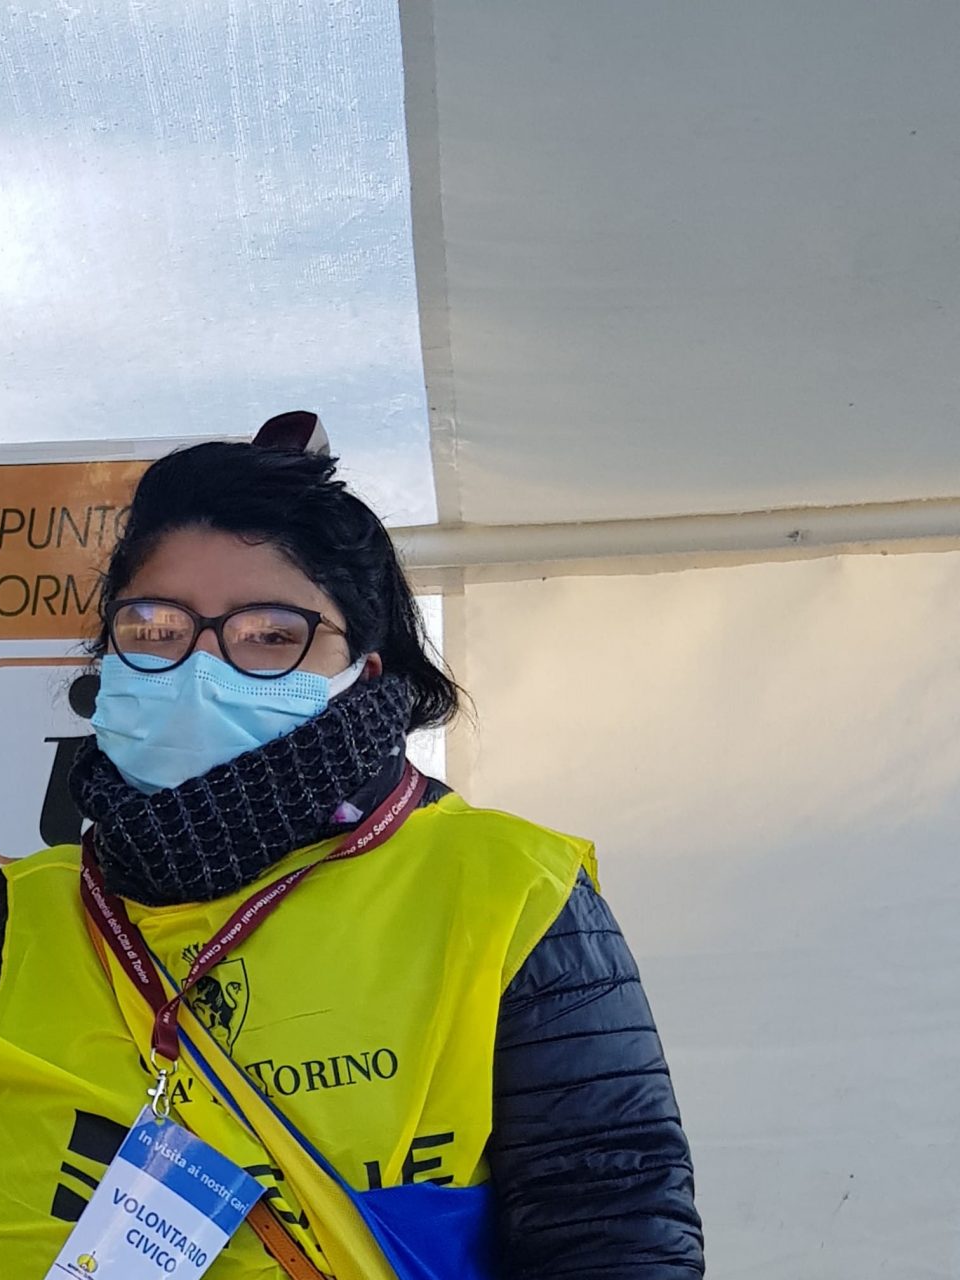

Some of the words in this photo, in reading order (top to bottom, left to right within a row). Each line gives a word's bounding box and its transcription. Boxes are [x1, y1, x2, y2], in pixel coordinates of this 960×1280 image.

[357, 832, 374, 848] Spa
[240, 884, 286, 924] Cimiteriali
[220, 922, 242, 944] della
[126, 950, 138, 959] di
[131, 959, 149, 984] Torino
[138, 1130, 152, 1146] In
[154, 1140, 187, 1168] visita
[187, 1164, 202, 1178] ai
[200, 1173, 234, 1202] nostri
[230, 1197, 249, 1215] cari
[113, 1187, 207, 1268] VOLONTARIO
[125, 1229, 178, 1274] CIVICO
